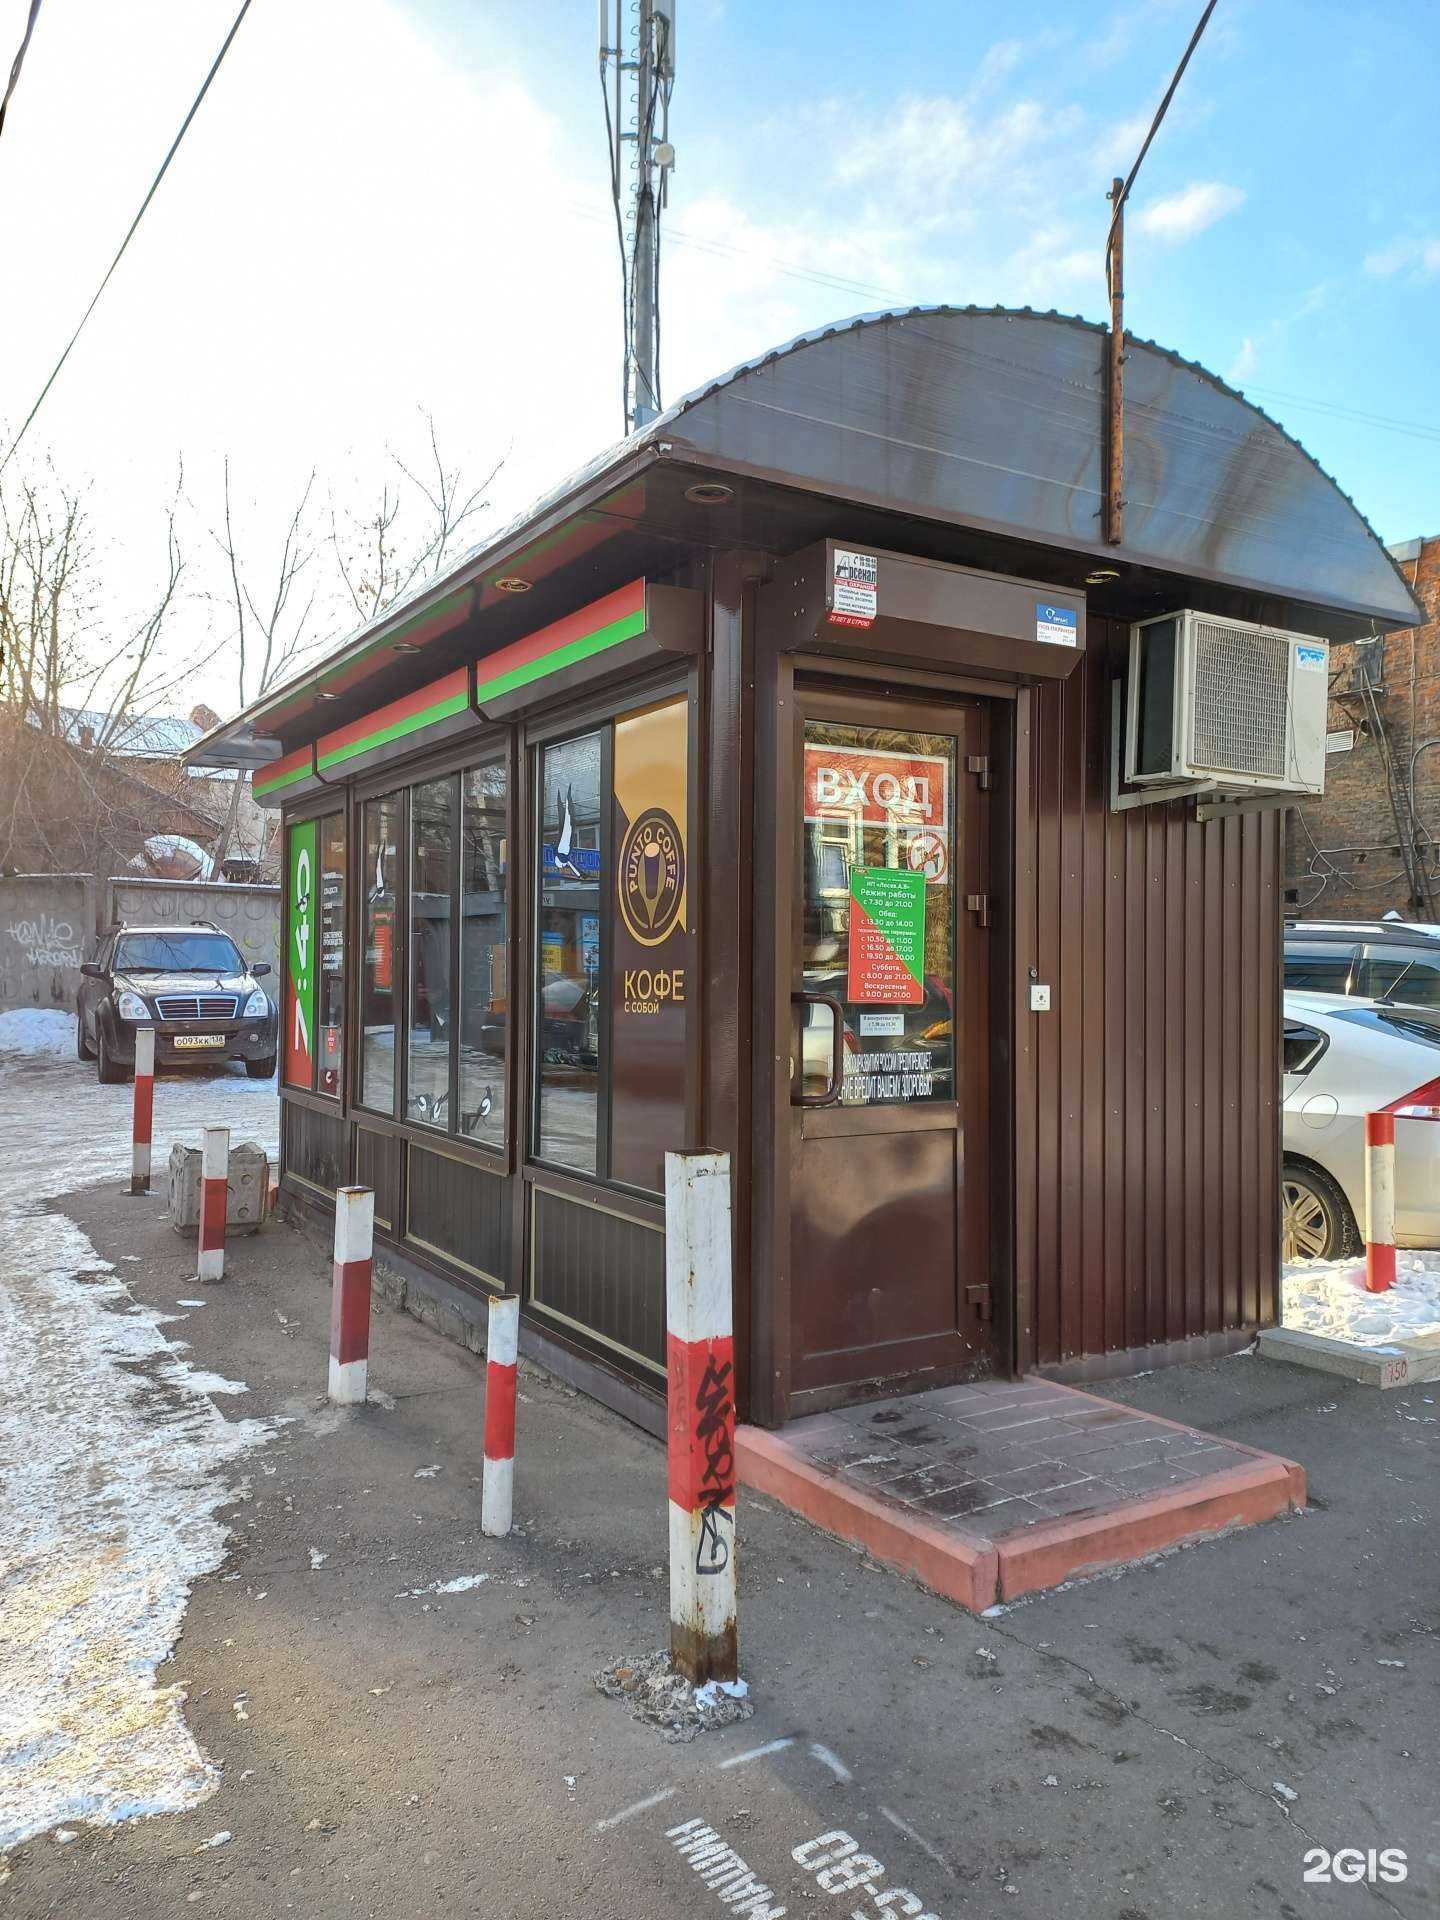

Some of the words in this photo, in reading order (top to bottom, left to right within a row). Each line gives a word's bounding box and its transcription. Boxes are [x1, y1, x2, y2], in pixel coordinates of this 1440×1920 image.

[817, 767, 932, 818] ВХОД
[628, 827, 652, 893] PUNTO
[861, 889, 886, 897] Режим
[888, 890, 916, 900] работы
[623, 969, 685, 1001] КОФЕ
[624, 1001, 630, 1013] С
[631, 999, 660, 1015] СОБОЙ
